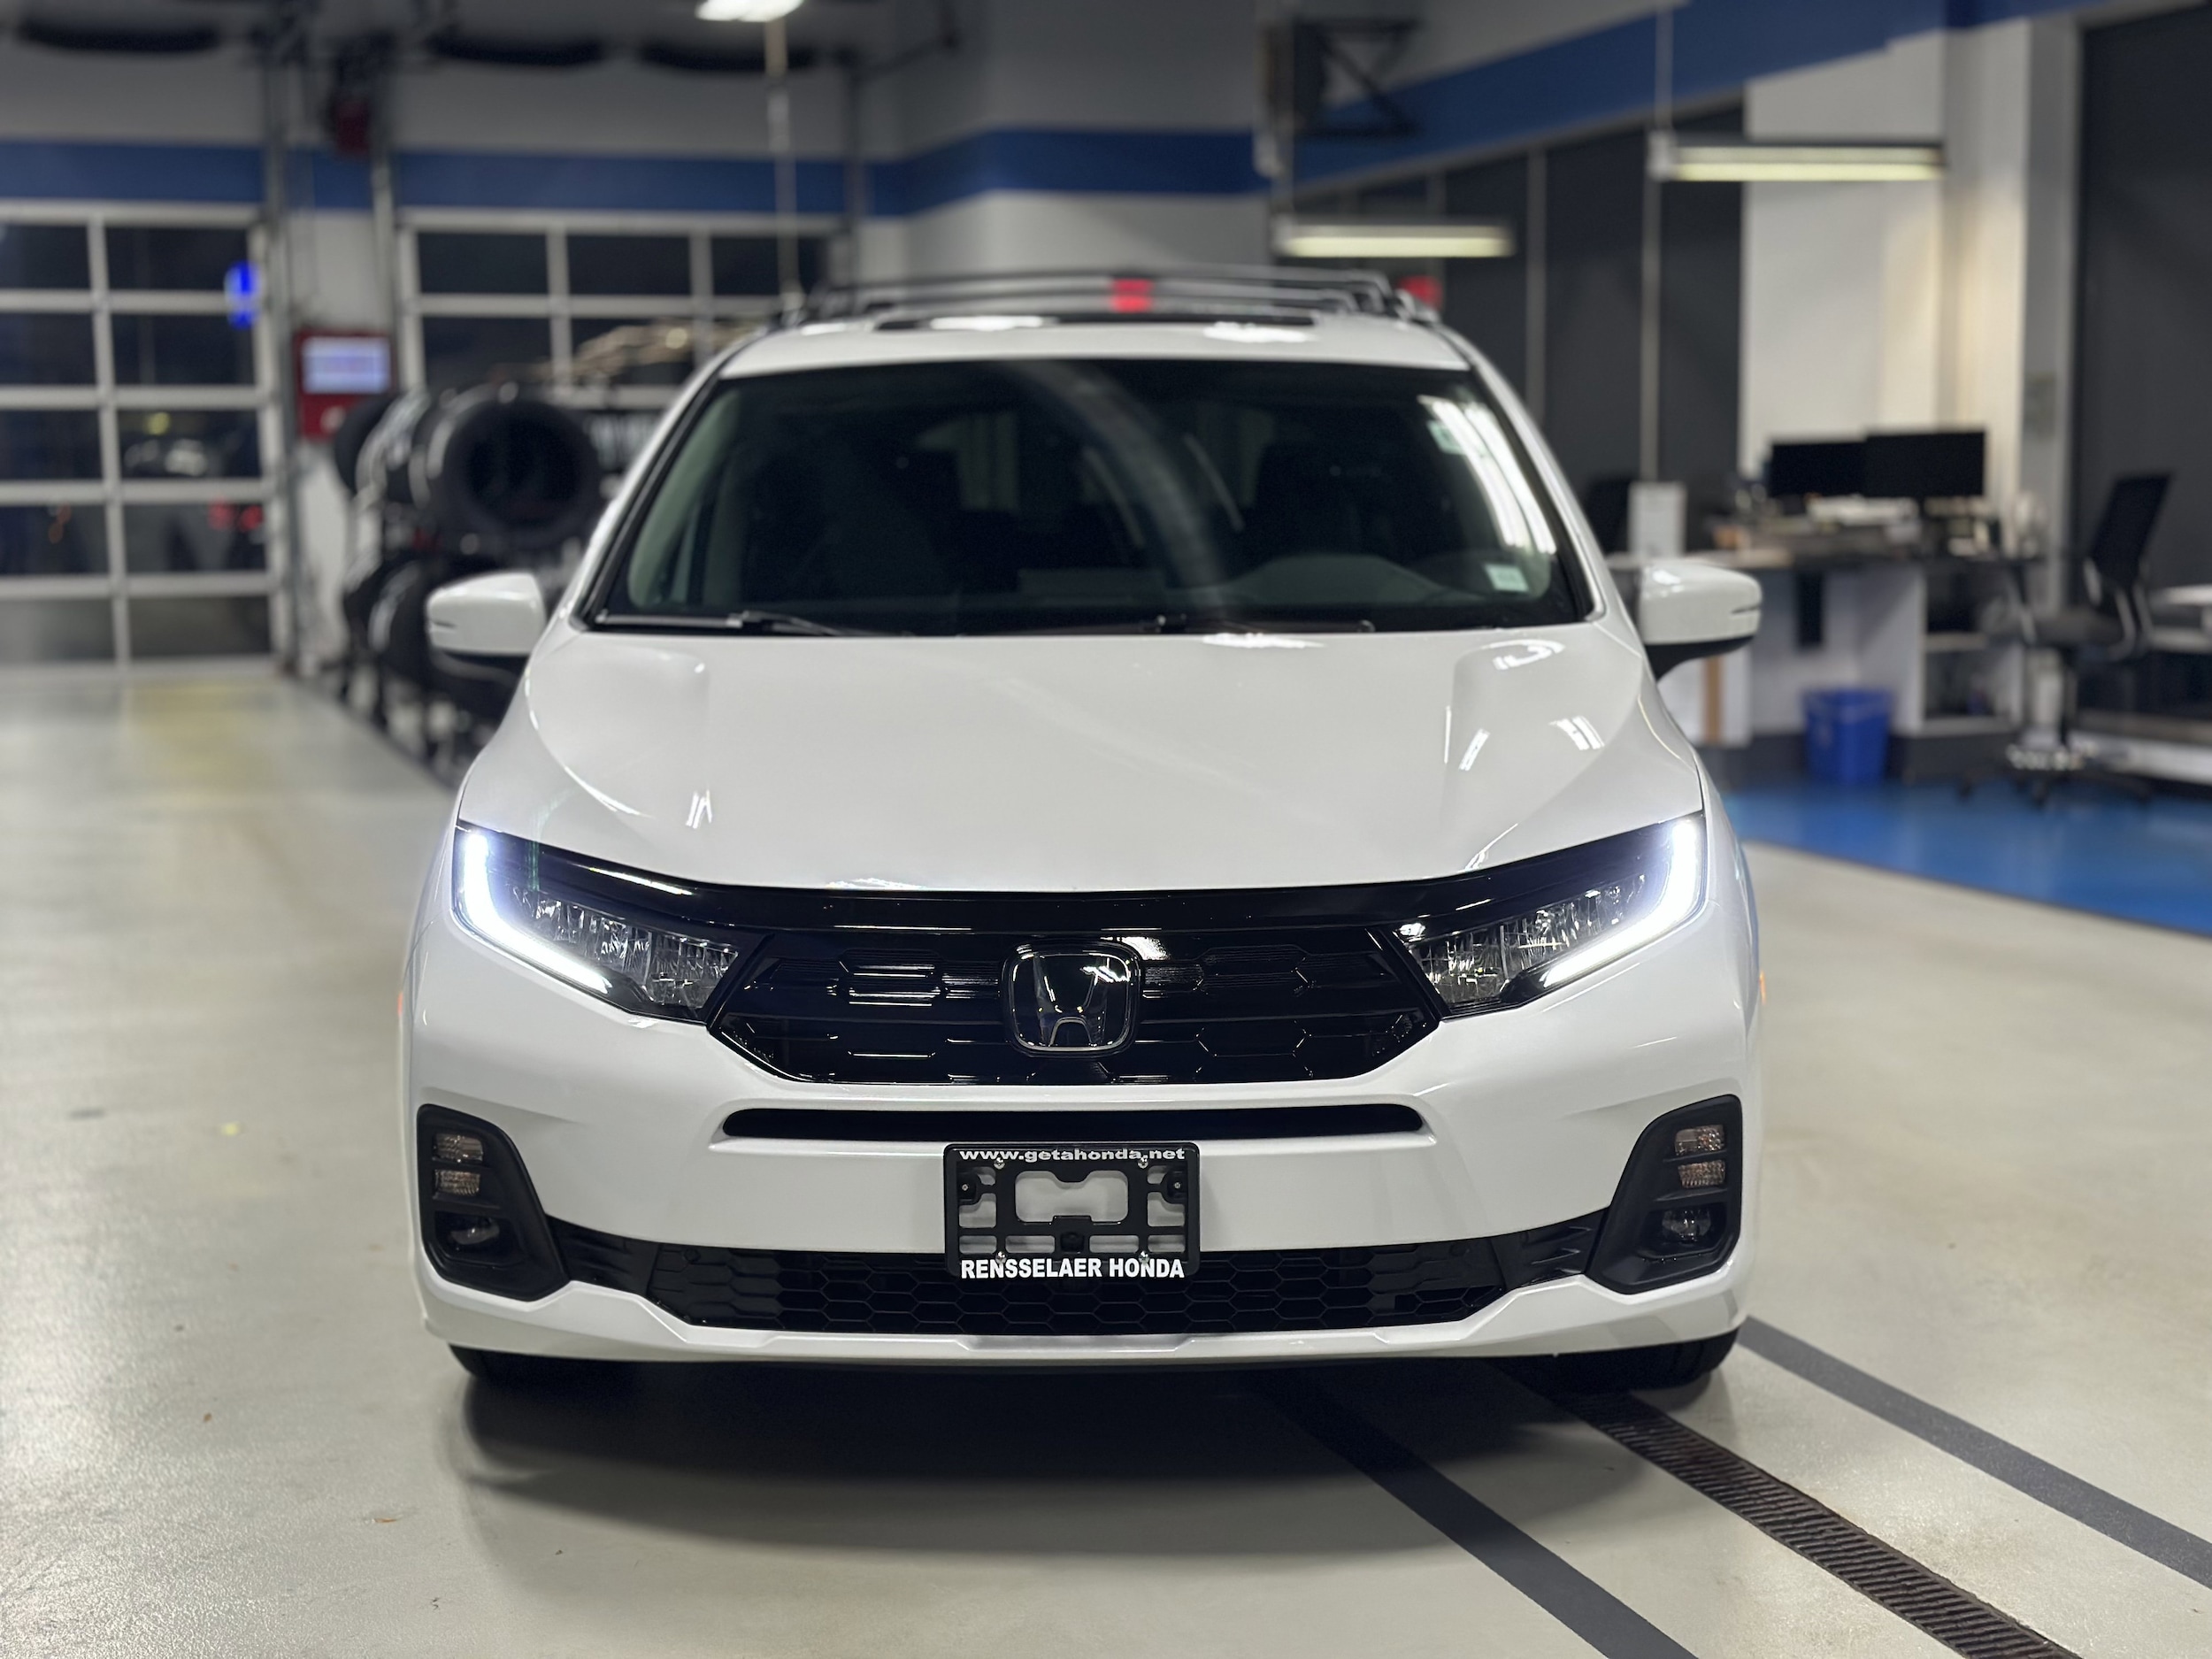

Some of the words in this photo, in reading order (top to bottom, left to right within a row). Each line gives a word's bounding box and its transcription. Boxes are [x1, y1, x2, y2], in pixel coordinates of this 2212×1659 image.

[960, 1148, 1186, 1162] www.getahonda.net
[961, 1258, 1102, 1279] RENSSELAER
[1109, 1258, 1185, 1279] HONDA
